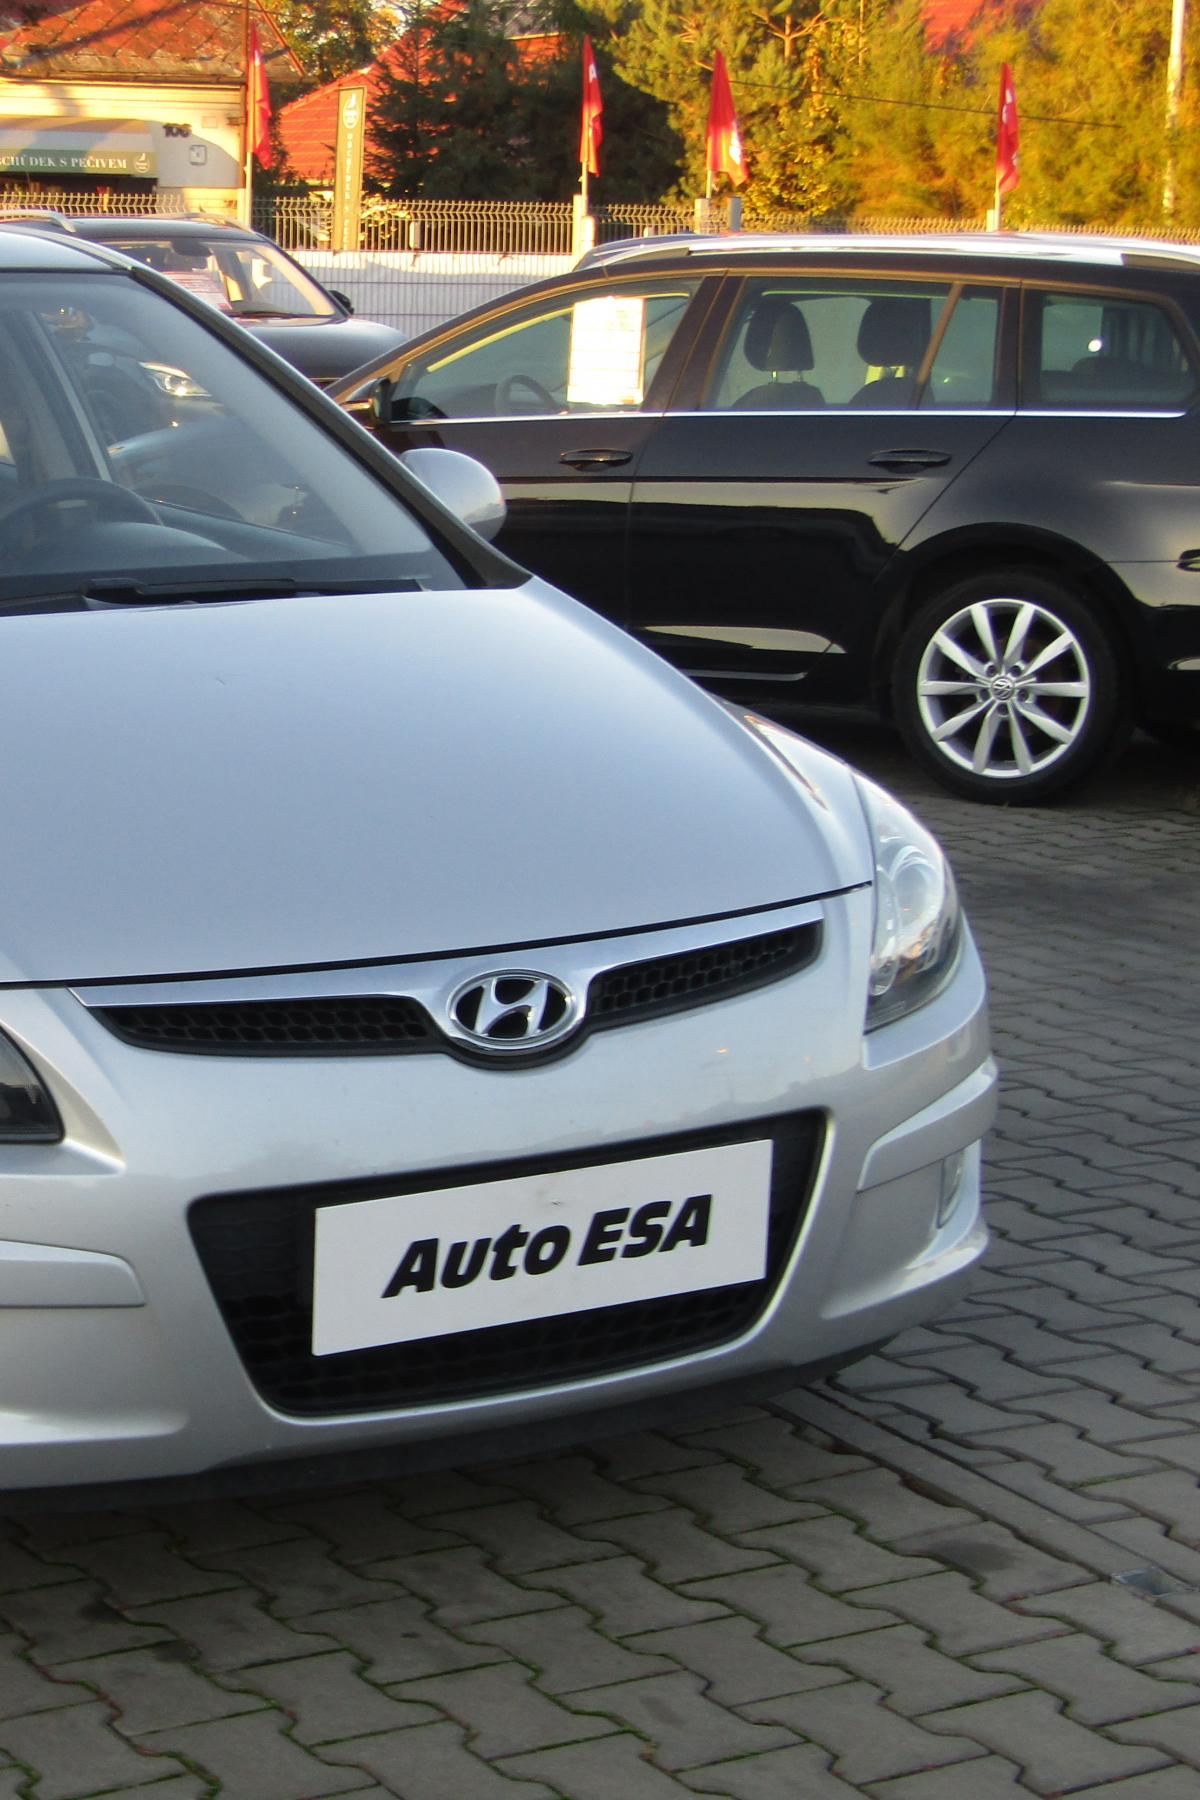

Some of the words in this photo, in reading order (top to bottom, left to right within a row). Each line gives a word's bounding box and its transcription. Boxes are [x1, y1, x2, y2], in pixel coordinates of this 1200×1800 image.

[59, 157, 68, 168] S
[71, 156, 128, 169] PEČIVEM
[380, 1223, 571, 1299] Auto
[576, 1193, 713, 1267] ESA
